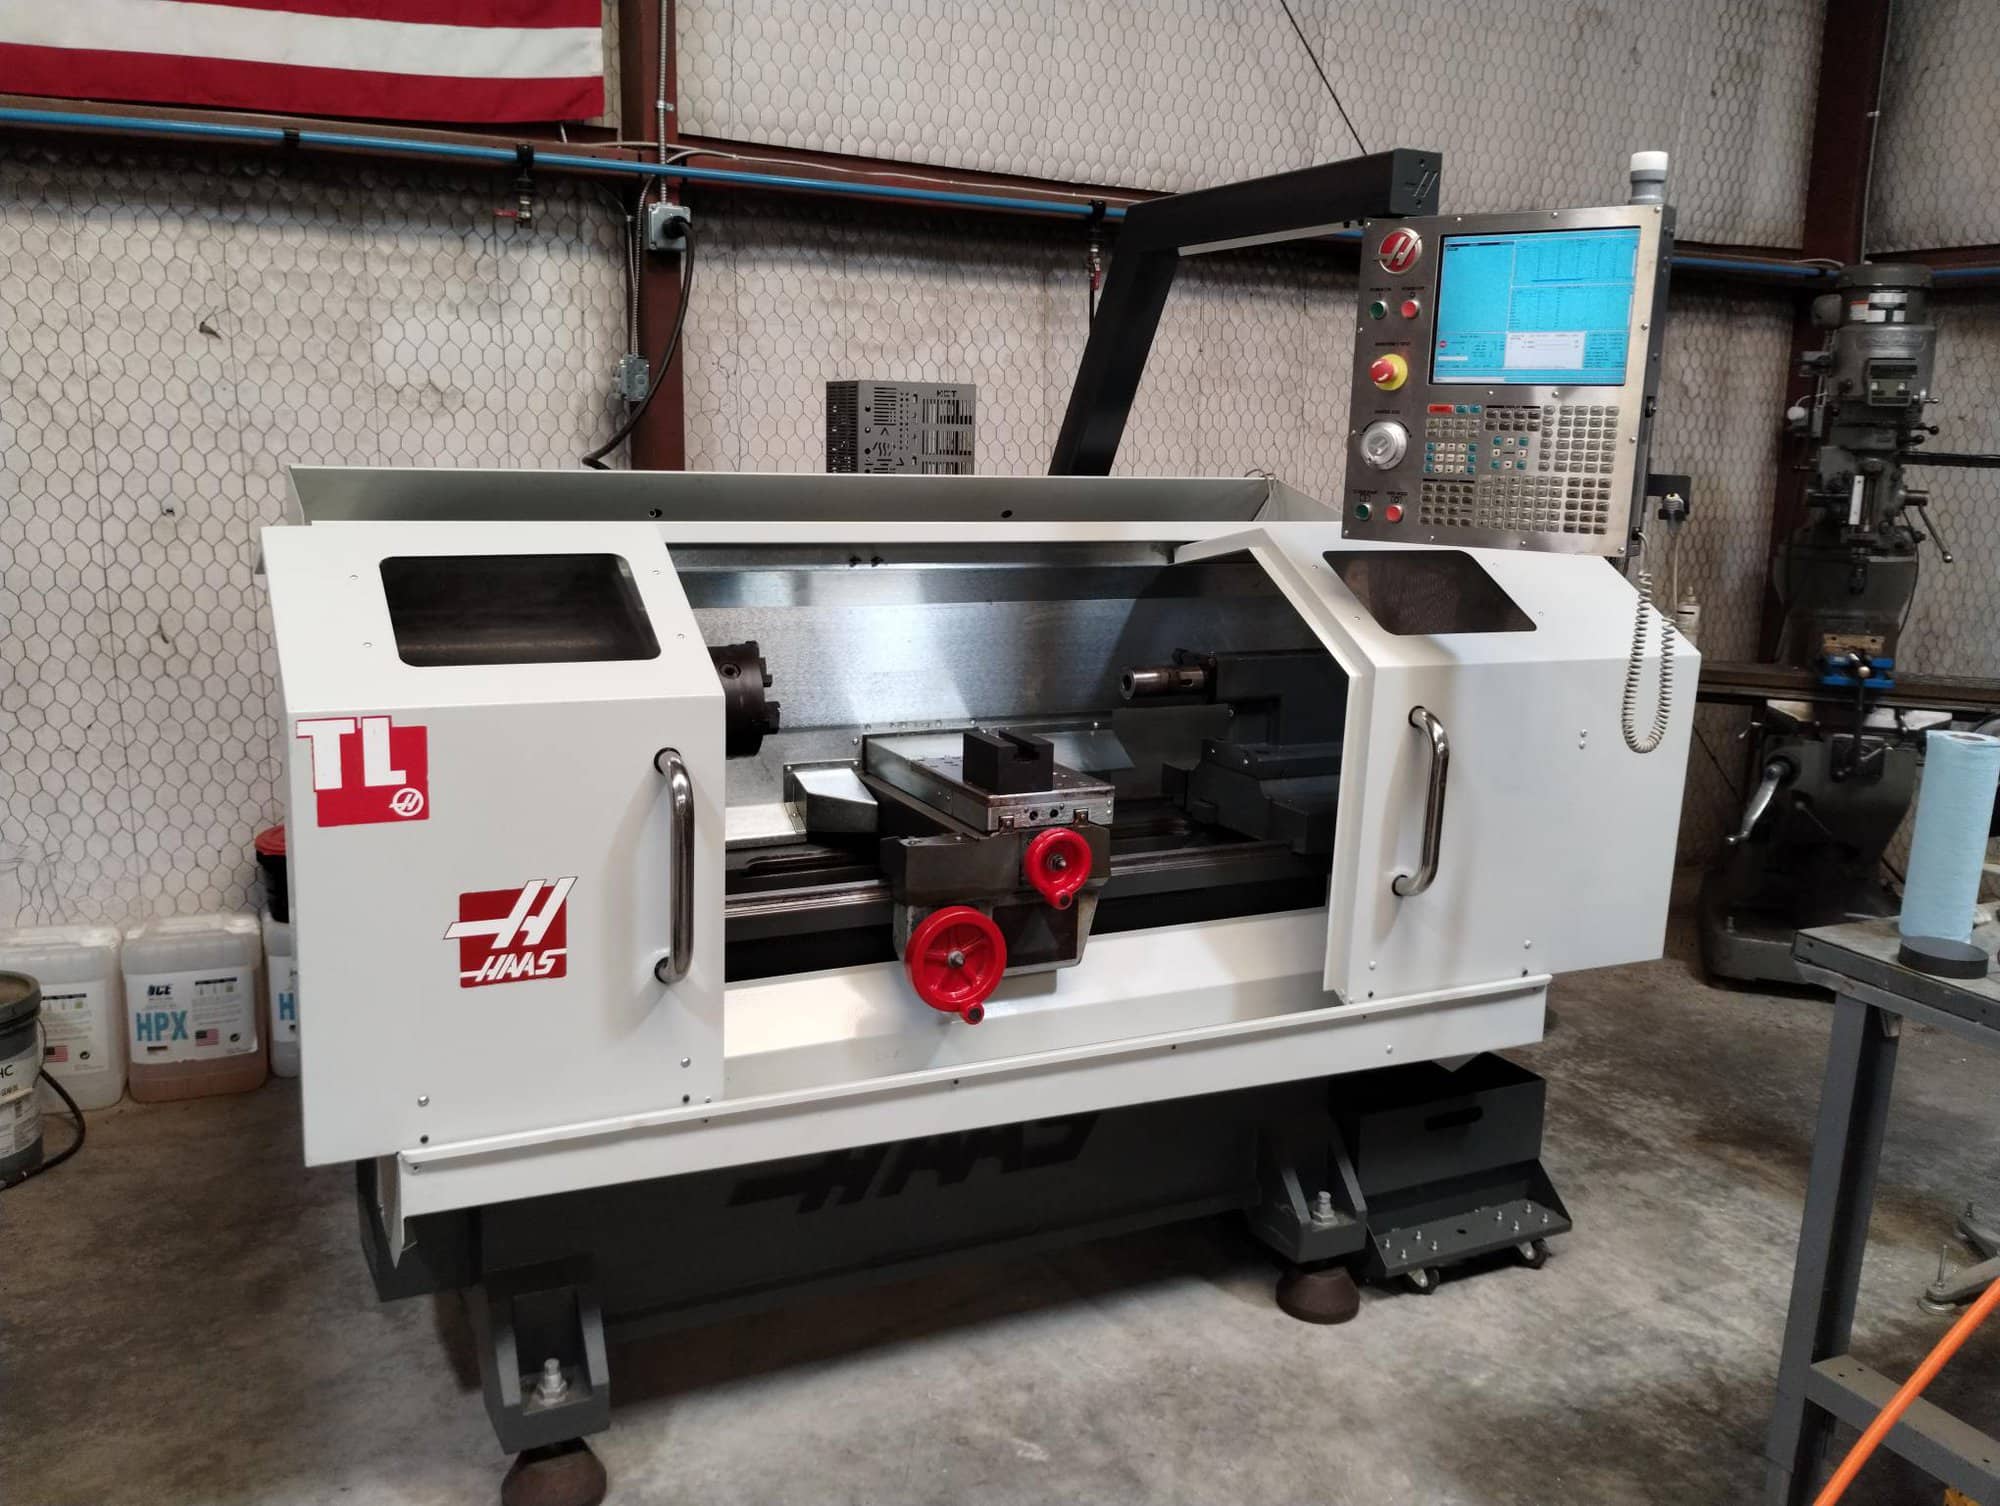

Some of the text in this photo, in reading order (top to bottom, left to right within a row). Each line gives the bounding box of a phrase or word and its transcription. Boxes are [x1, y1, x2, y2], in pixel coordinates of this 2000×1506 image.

[295, 715, 407, 792] TL
[460, 949, 567, 983] HAAS
[136, 1010, 188, 1041] HPX
